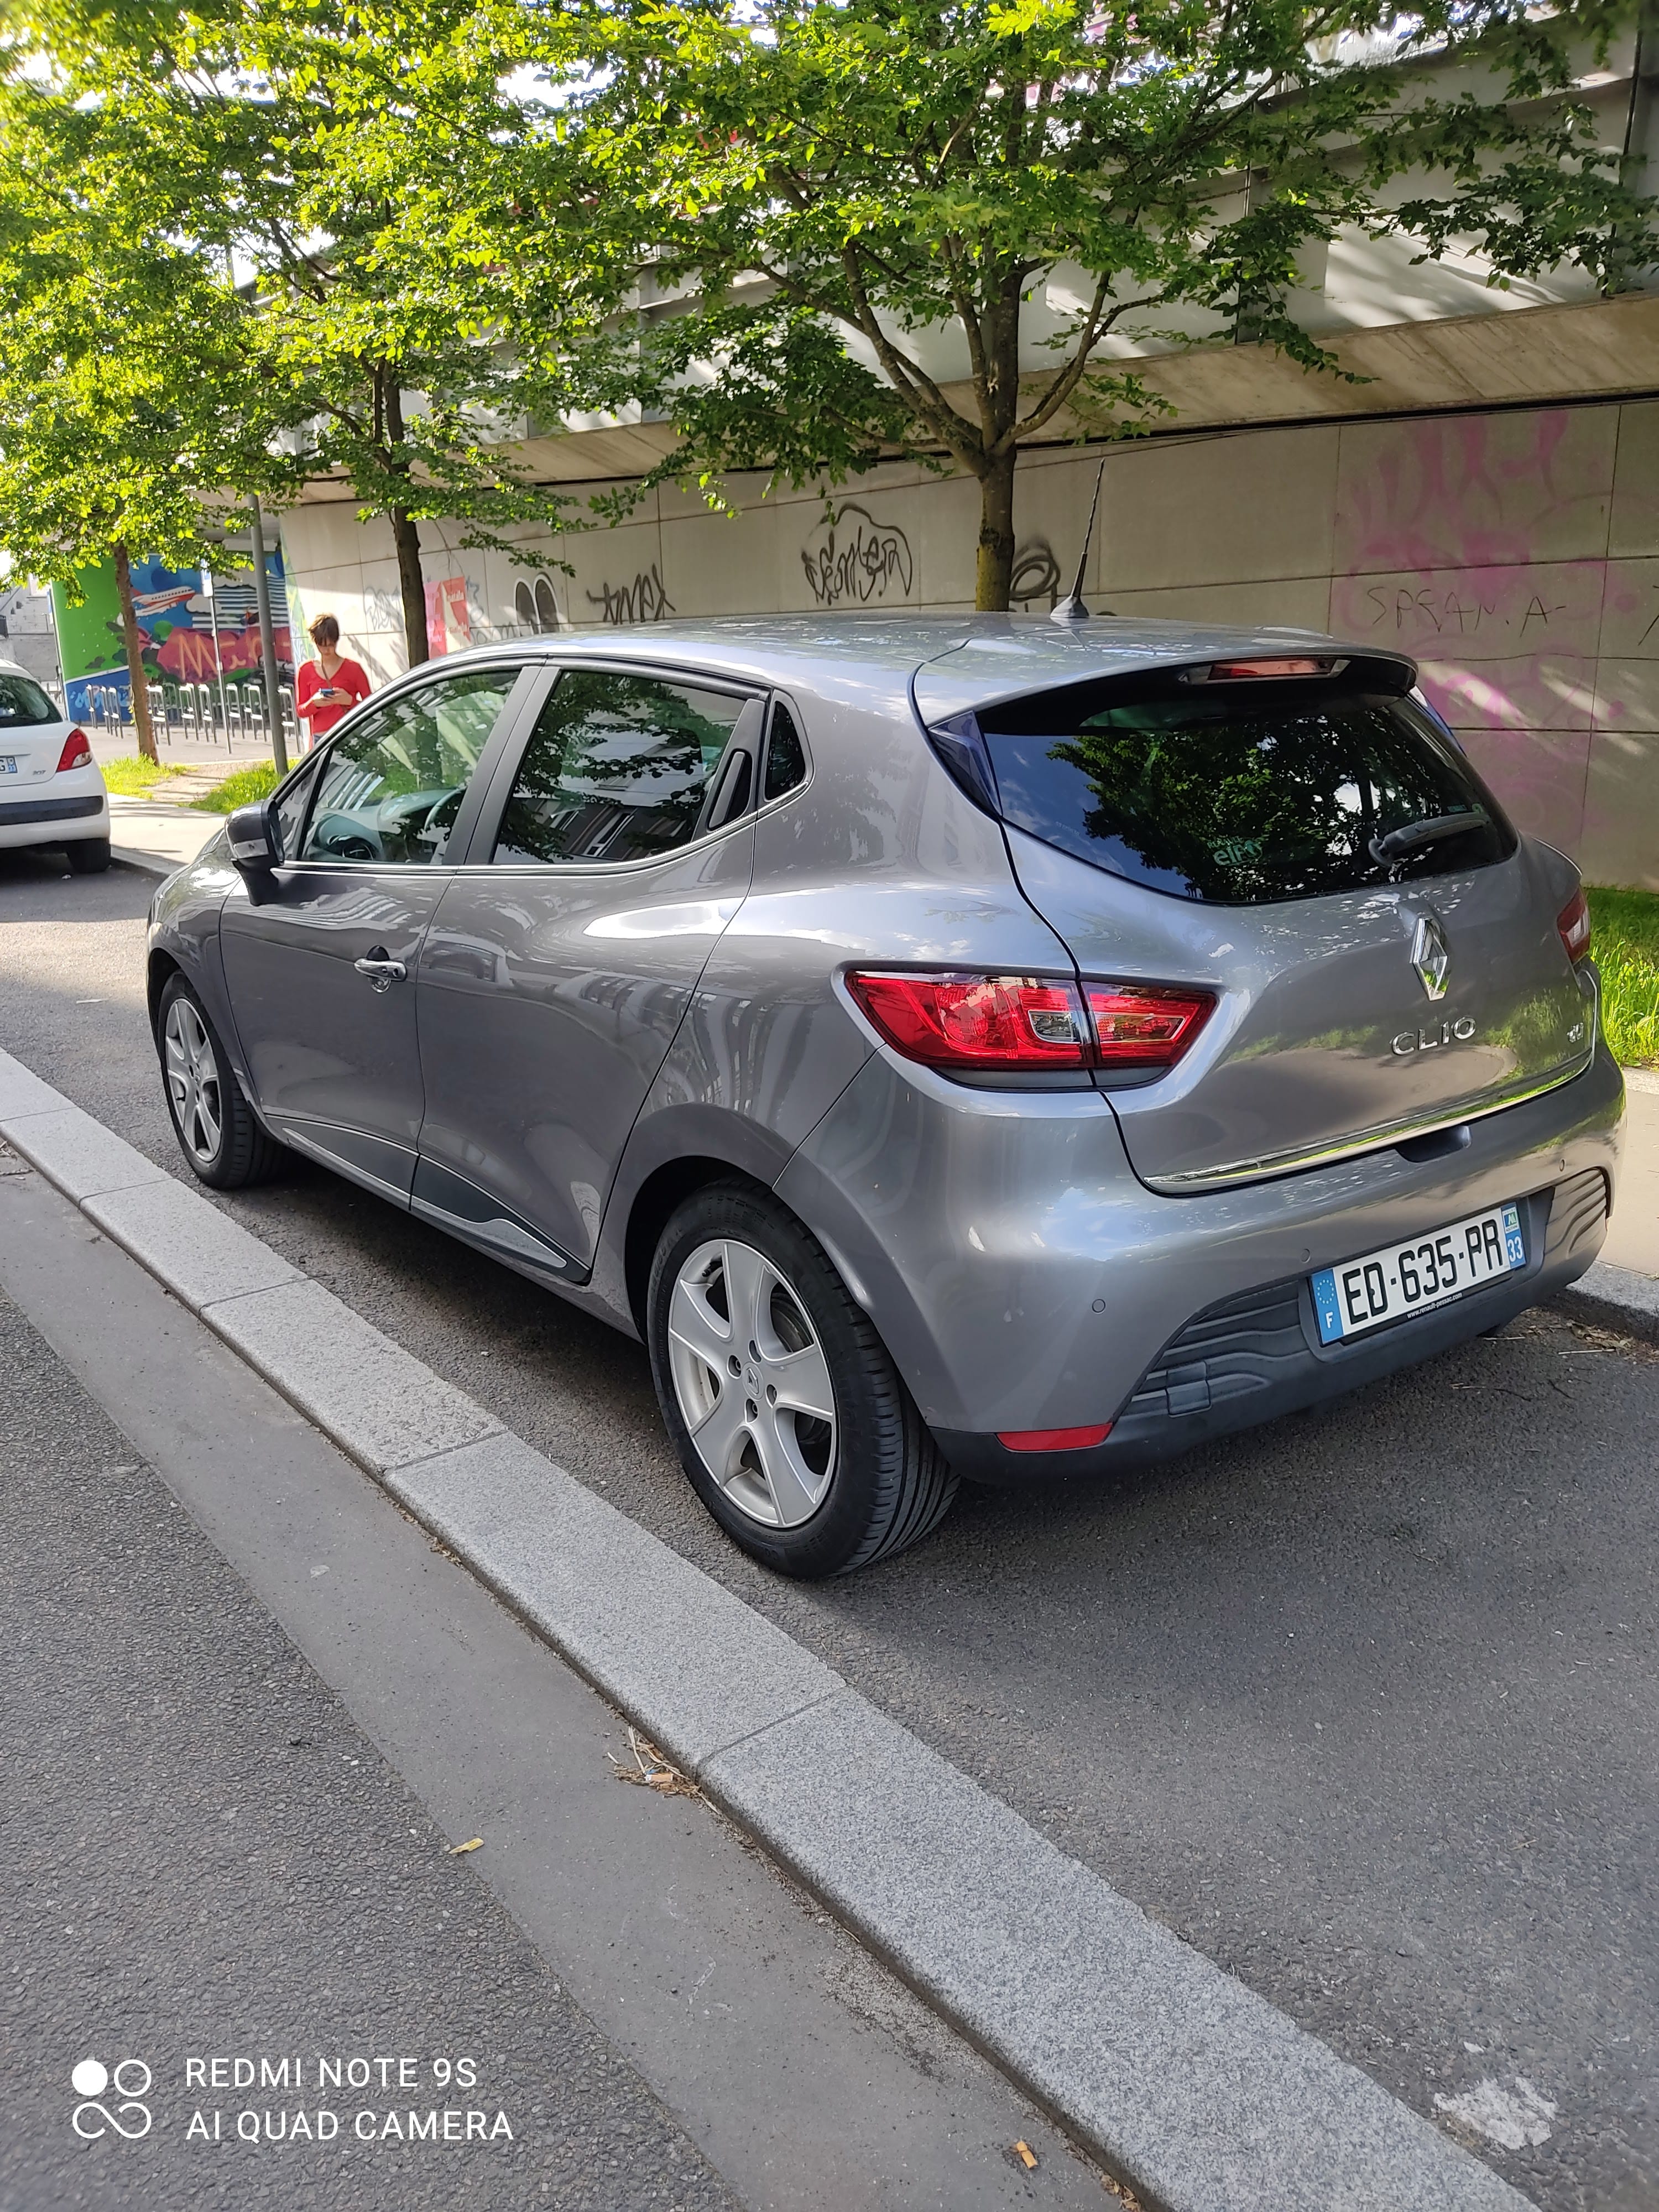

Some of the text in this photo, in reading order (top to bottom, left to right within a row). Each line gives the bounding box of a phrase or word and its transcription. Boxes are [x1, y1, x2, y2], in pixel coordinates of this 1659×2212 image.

[1392, 1016, 1477, 1056] CLIO
[1507, 1236, 1524, 1262] 33
[1406, 1292, 1463, 1319] www.renault-pessac.com
[1325, 1311, 1333, 1329] F
